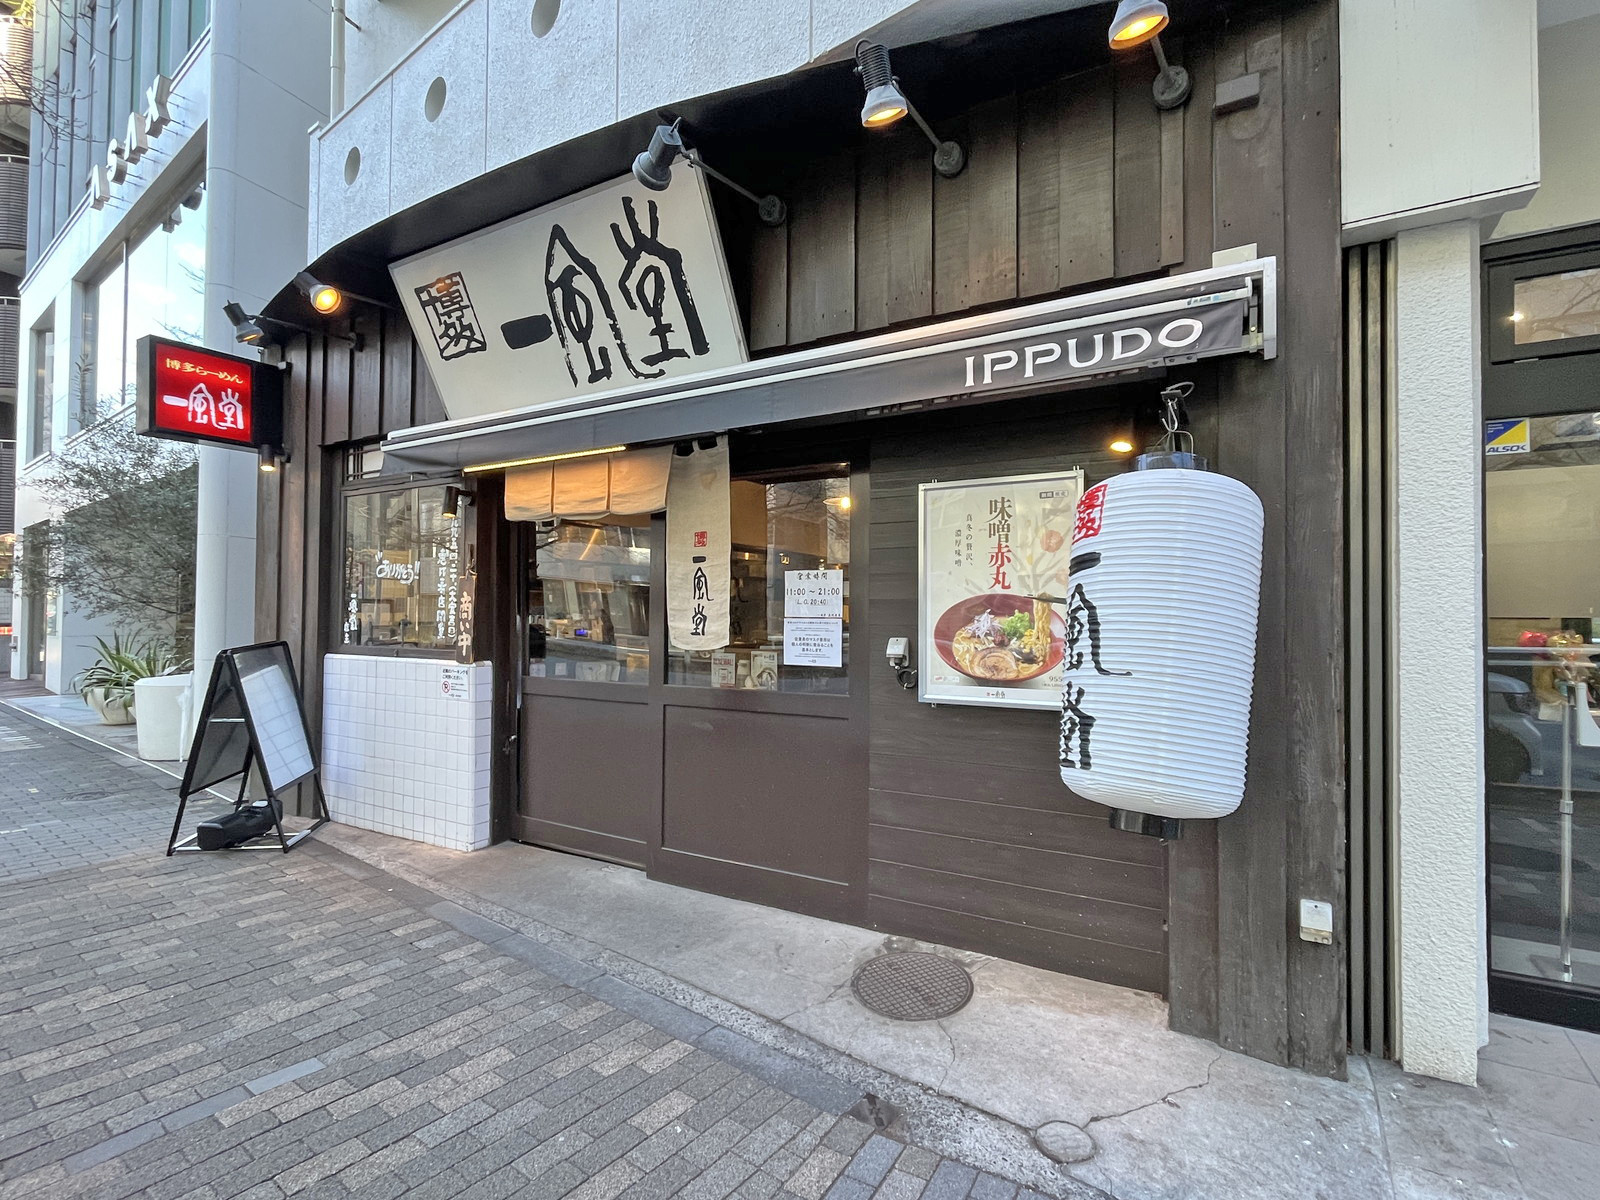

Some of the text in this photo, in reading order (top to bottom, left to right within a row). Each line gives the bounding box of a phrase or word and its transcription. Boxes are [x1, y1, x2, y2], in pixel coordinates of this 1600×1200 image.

[500, 196, 710, 388] 一風堂
[165, 358, 244, 384] 博多らーめん
[964, 318, 1204, 388] IPPUDO
[162, 382, 244, 430] 一風堂
[1486, 444, 1526, 454] ALSOK
[985, 496, 1013, 590] 味噌赤丸
[458, 590, 472, 657] 商い中
[690, 555, 714, 637] 一風堂
[786, 587, 806, 596] 11:00
[818, 587, 840, 596] 21:00
